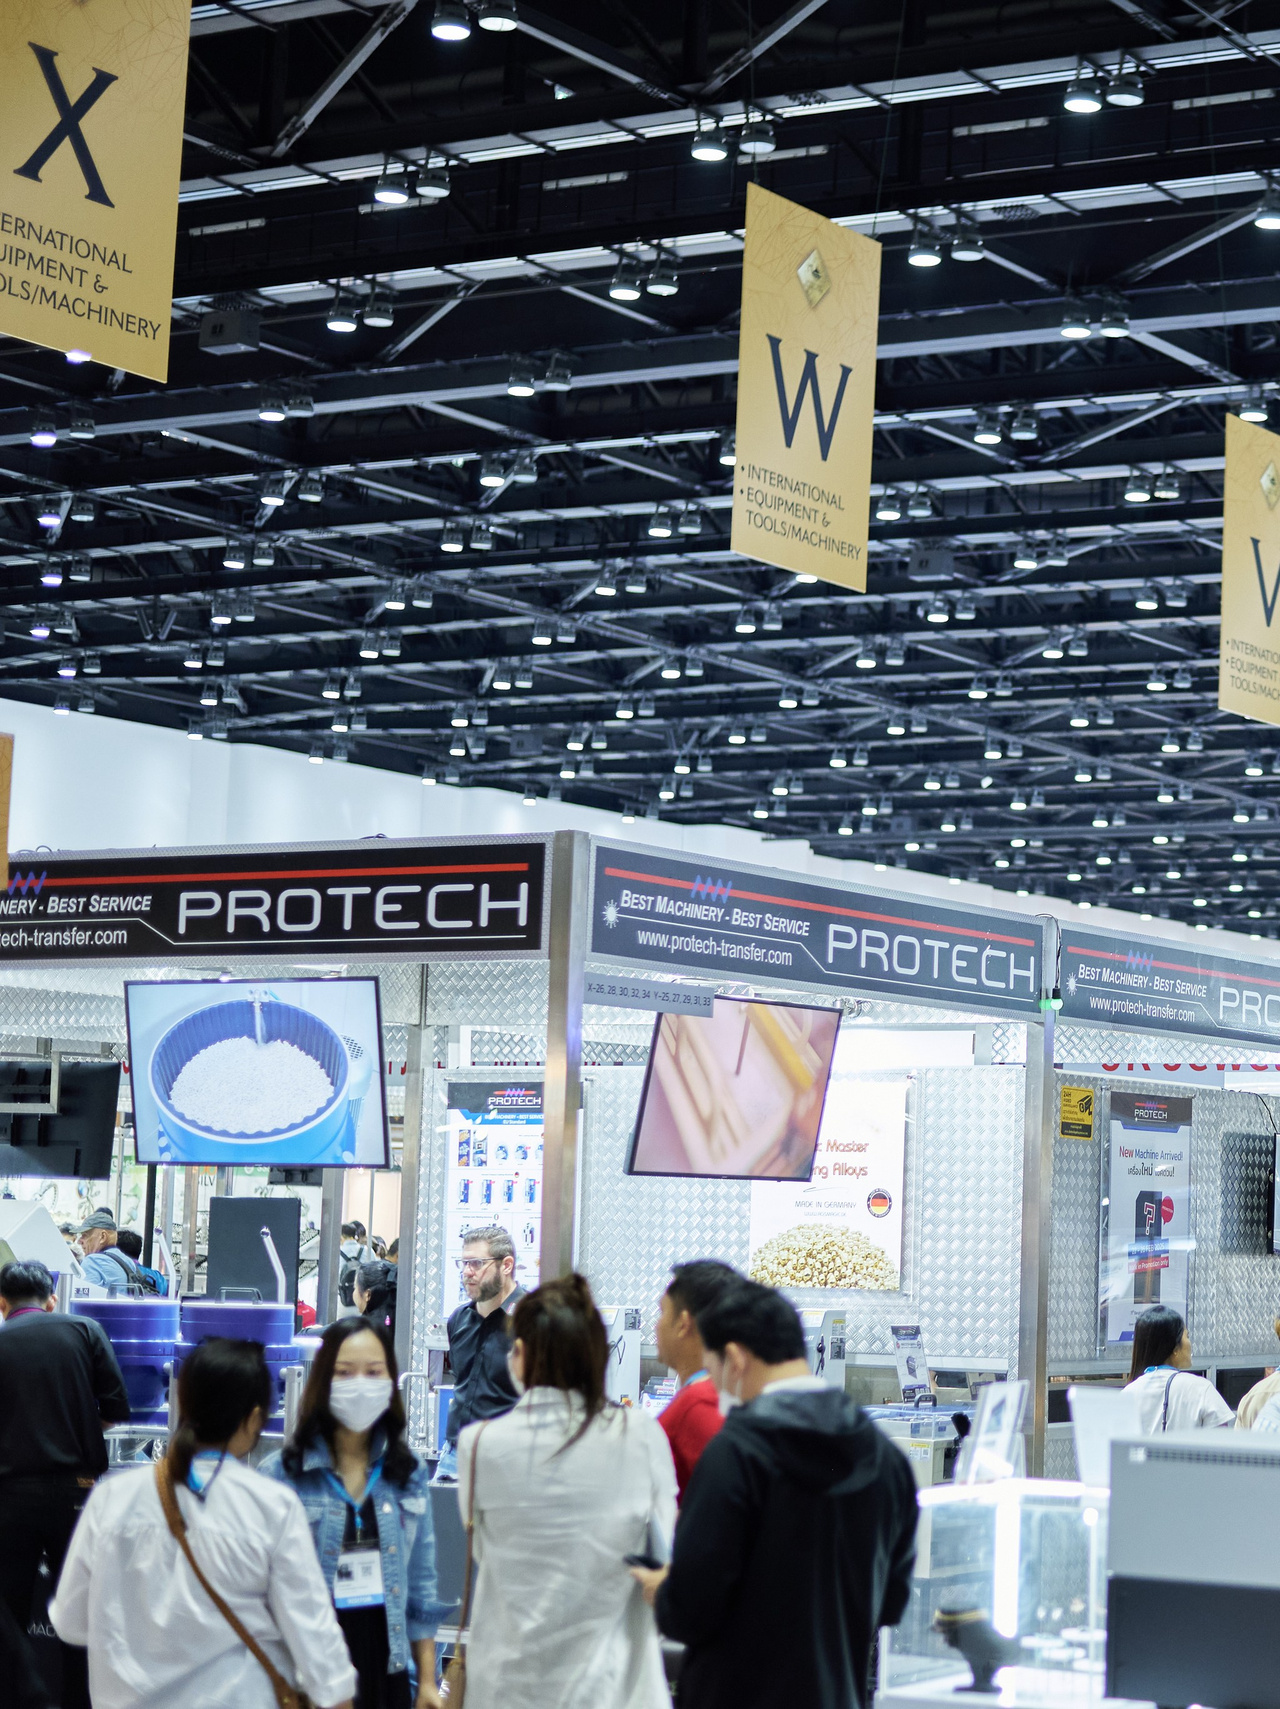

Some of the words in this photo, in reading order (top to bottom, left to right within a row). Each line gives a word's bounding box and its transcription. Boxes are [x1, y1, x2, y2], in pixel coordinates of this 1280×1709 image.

[13, 41, 118, 209] X
[0, 212, 132, 274] ERNATIONAL
[93, 273, 108, 293] &
[766, 333, 853, 462] W
[748, 463, 844, 511] INTERNATIONAL
[747, 487, 819, 525] EQUIPMENT
[821, 512, 831, 528] &
[746, 509, 861, 560] TOOLS/MACHINERY
[1230, 656, 1278, 682] EQUIPMENT
[47, 896, 86, 914] BEST
[88, 894, 152, 914] SERVICE
[178, 882, 528, 935] PROTECH
[621, 889, 654, 911] BEST
[655, 896, 724, 923] MACHINERY
[731, 908, 763, 928] BEST
[764, 913, 810, 937] SERVICE
[637, 929, 792, 966] www.protech-transfer.com
[827, 923, 1035, 993] PROTECH
[1078, 964, 1100, 981] BEST
[1102, 967, 1149, 989] MACHINERY
[1153, 976, 1174, 993] BEST
[1175, 981, 1207, 998] SERVICE
[642, 989, 651, 999] 34
[702, 996, 711, 1006] 33
[1089, 993, 1195, 1023] www.protech-transfer.com
[488, 1097, 541, 1105] PROTECH
[1134, 1109, 1167, 1119] PROTECH
[826, 1139, 869, 1153] Master
[1119, 1146, 1134, 1158] New
[1135, 1148, 1159, 1160] Machine
[1160, 1150, 1183, 1161] Arrived!
[832, 1162, 868, 1179] Alloys
[795, 1200, 813, 1208] MADE
[824, 1201, 856, 1209] GERMANY
